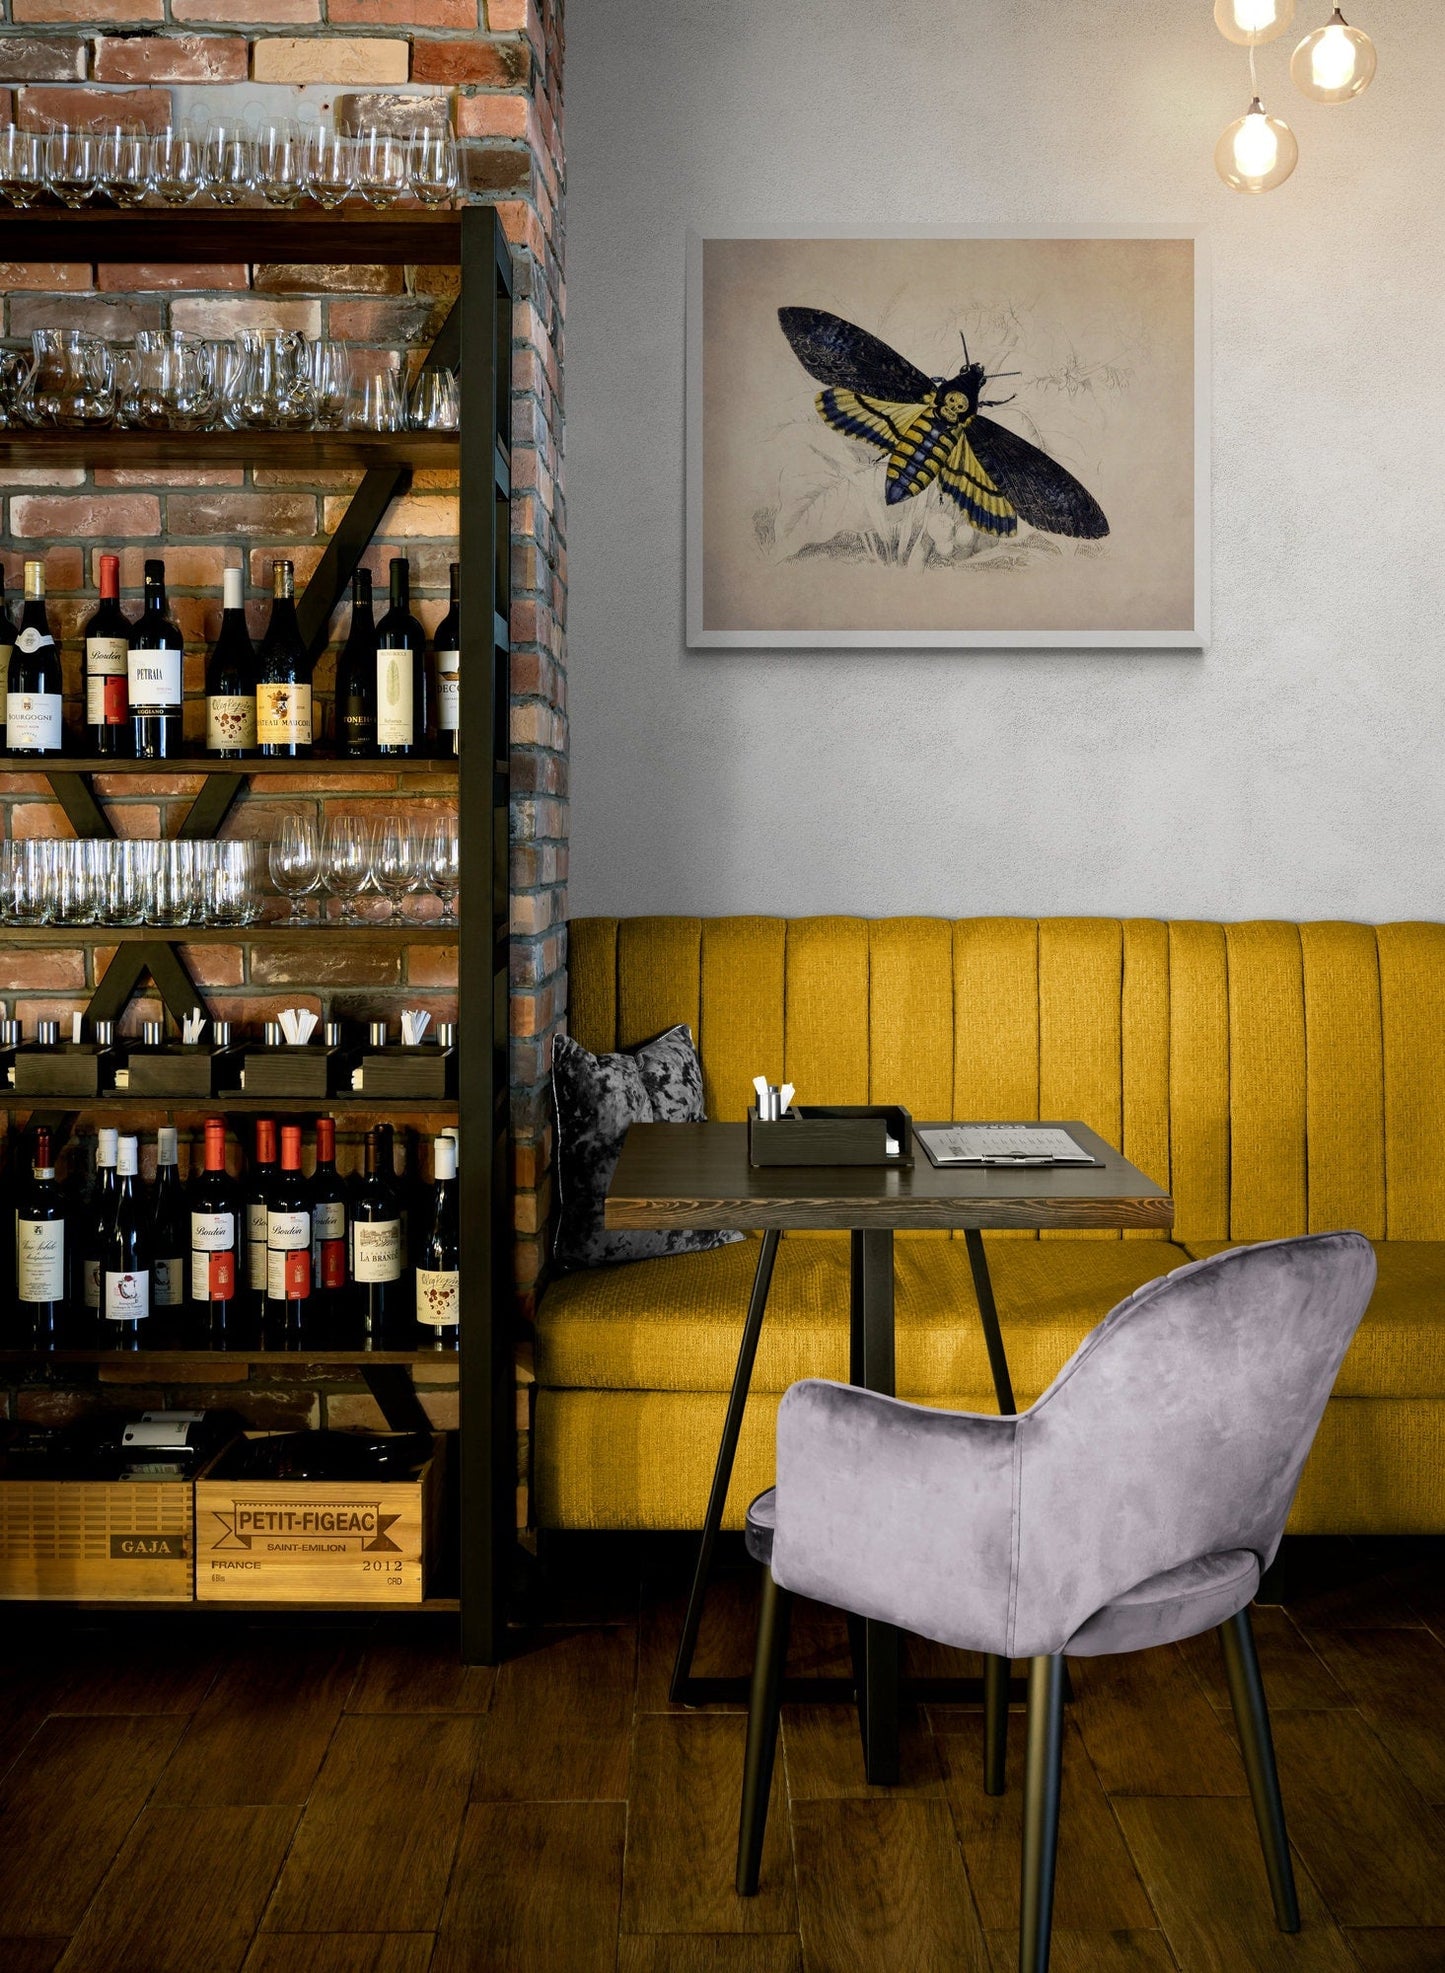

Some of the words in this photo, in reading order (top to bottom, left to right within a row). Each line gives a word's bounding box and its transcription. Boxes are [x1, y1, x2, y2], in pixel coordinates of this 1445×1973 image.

[8, 713, 52, 721] BOURGOGNE
[239, 1511, 375, 1531] PETIT-FIGEAC
[121, 1541, 171, 1553] GAJA
[267, 1543, 346, 1552] SAINT-EMILION
[211, 1560, 261, 1570] FRANCE
[363, 1561, 402, 1571] 2012
